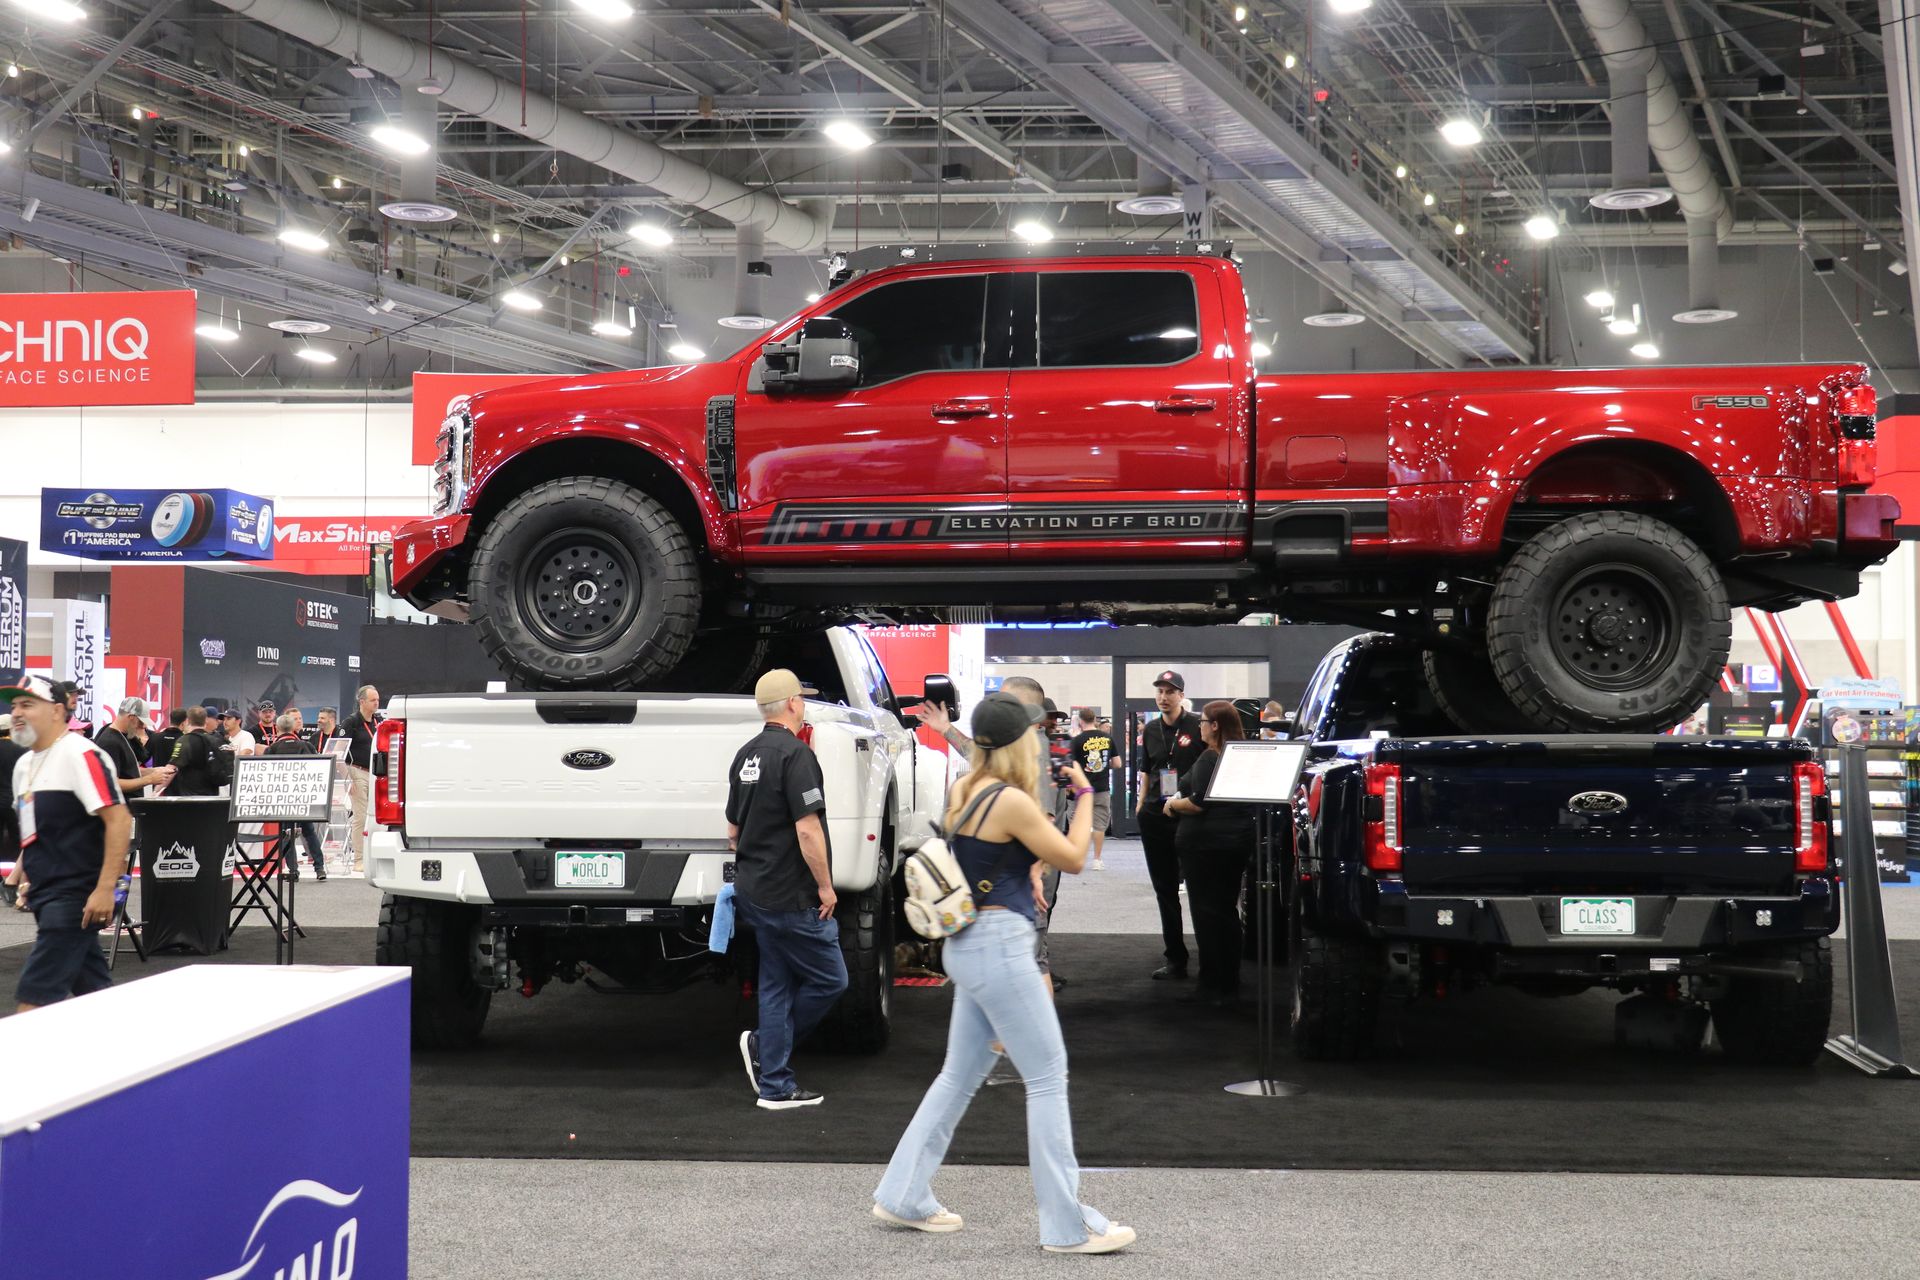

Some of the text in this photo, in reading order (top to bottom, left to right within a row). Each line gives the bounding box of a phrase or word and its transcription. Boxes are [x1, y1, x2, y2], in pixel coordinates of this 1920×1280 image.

[1186, 211, 1202, 226] W
[1187, 229, 1201, 240] 11
[58, 367, 150, 384] SCIENCE
[1692, 395, 1769, 410] F550
[718, 409, 731, 445] F550
[61, 506, 92, 515] BUFF
[104, 506, 140, 516] SHINE
[951, 516, 1201, 529] ELEVATION OFF GRID
[274, 523, 392, 543] MaxShine
[86, 538, 132, 546] AMERICA
[307, 601, 333, 620] STEK
[0, 576, 13, 668] SERUM
[257, 646, 280, 660] DYNO
[74, 610, 85, 721] CYSTAL
[81, 634, 94, 722] SERUM
[1863, 690, 1901, 699] Fresheners
[242, 762, 308, 772] THIS TRUCK
[240, 773, 324, 783] HAS THE SAME
[240, 783, 327, 793] PAYLOAD AS AN
[616, 779, 730, 793] DUT
[238, 794, 317, 804] F-450 PICKUP
[1583, 795, 1616, 809] Ford
[236, 805, 310, 817] [REMAINING]
[159, 862, 193, 871] EOG
[572, 863, 608, 878] WORLD
[1579, 909, 1617, 924] CLASS
